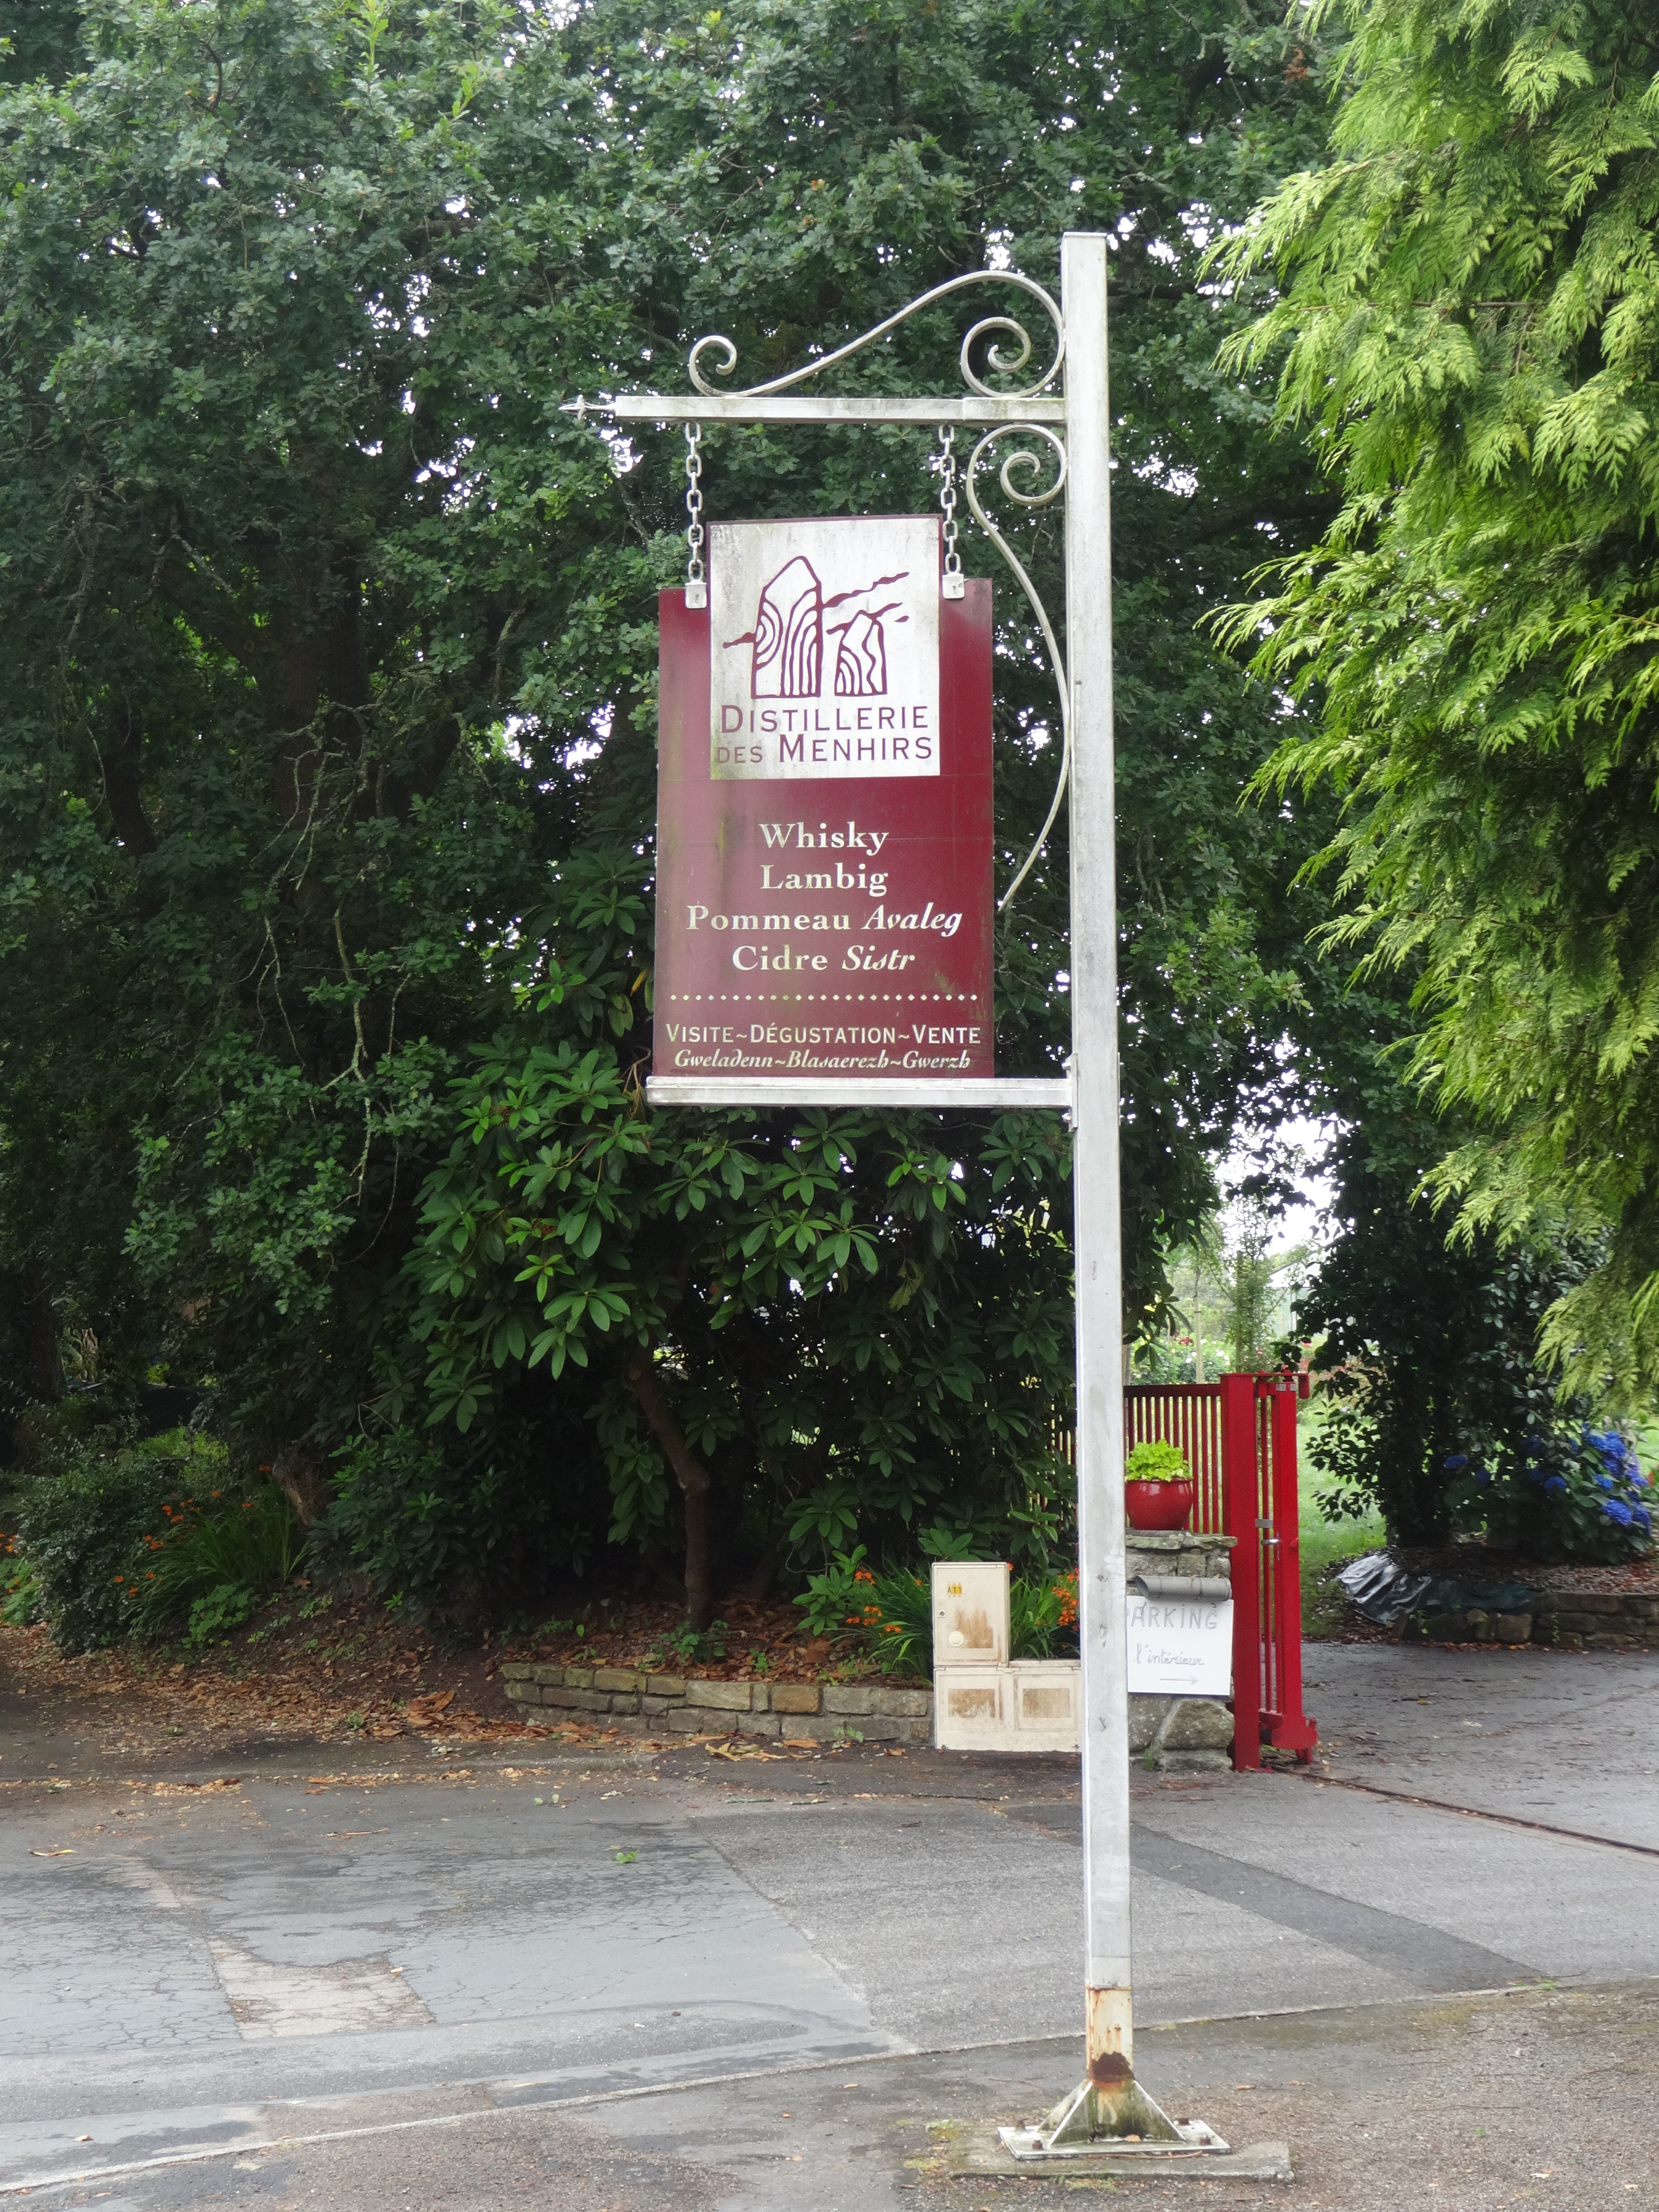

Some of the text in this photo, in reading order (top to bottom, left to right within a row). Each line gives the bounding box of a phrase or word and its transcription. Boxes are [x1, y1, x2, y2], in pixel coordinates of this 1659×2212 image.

[721, 705, 928, 733] DISTILLERIE
[717, 734, 932, 764] DES MENHIRS
[759, 821, 890, 856] Whisky
[760, 862, 888, 897] Lambig
[686, 902, 963, 937] Pommeau Avaleg
[732, 944, 915, 971] Cidre Sistr
[1127, 1604, 1218, 1630] ARKING
